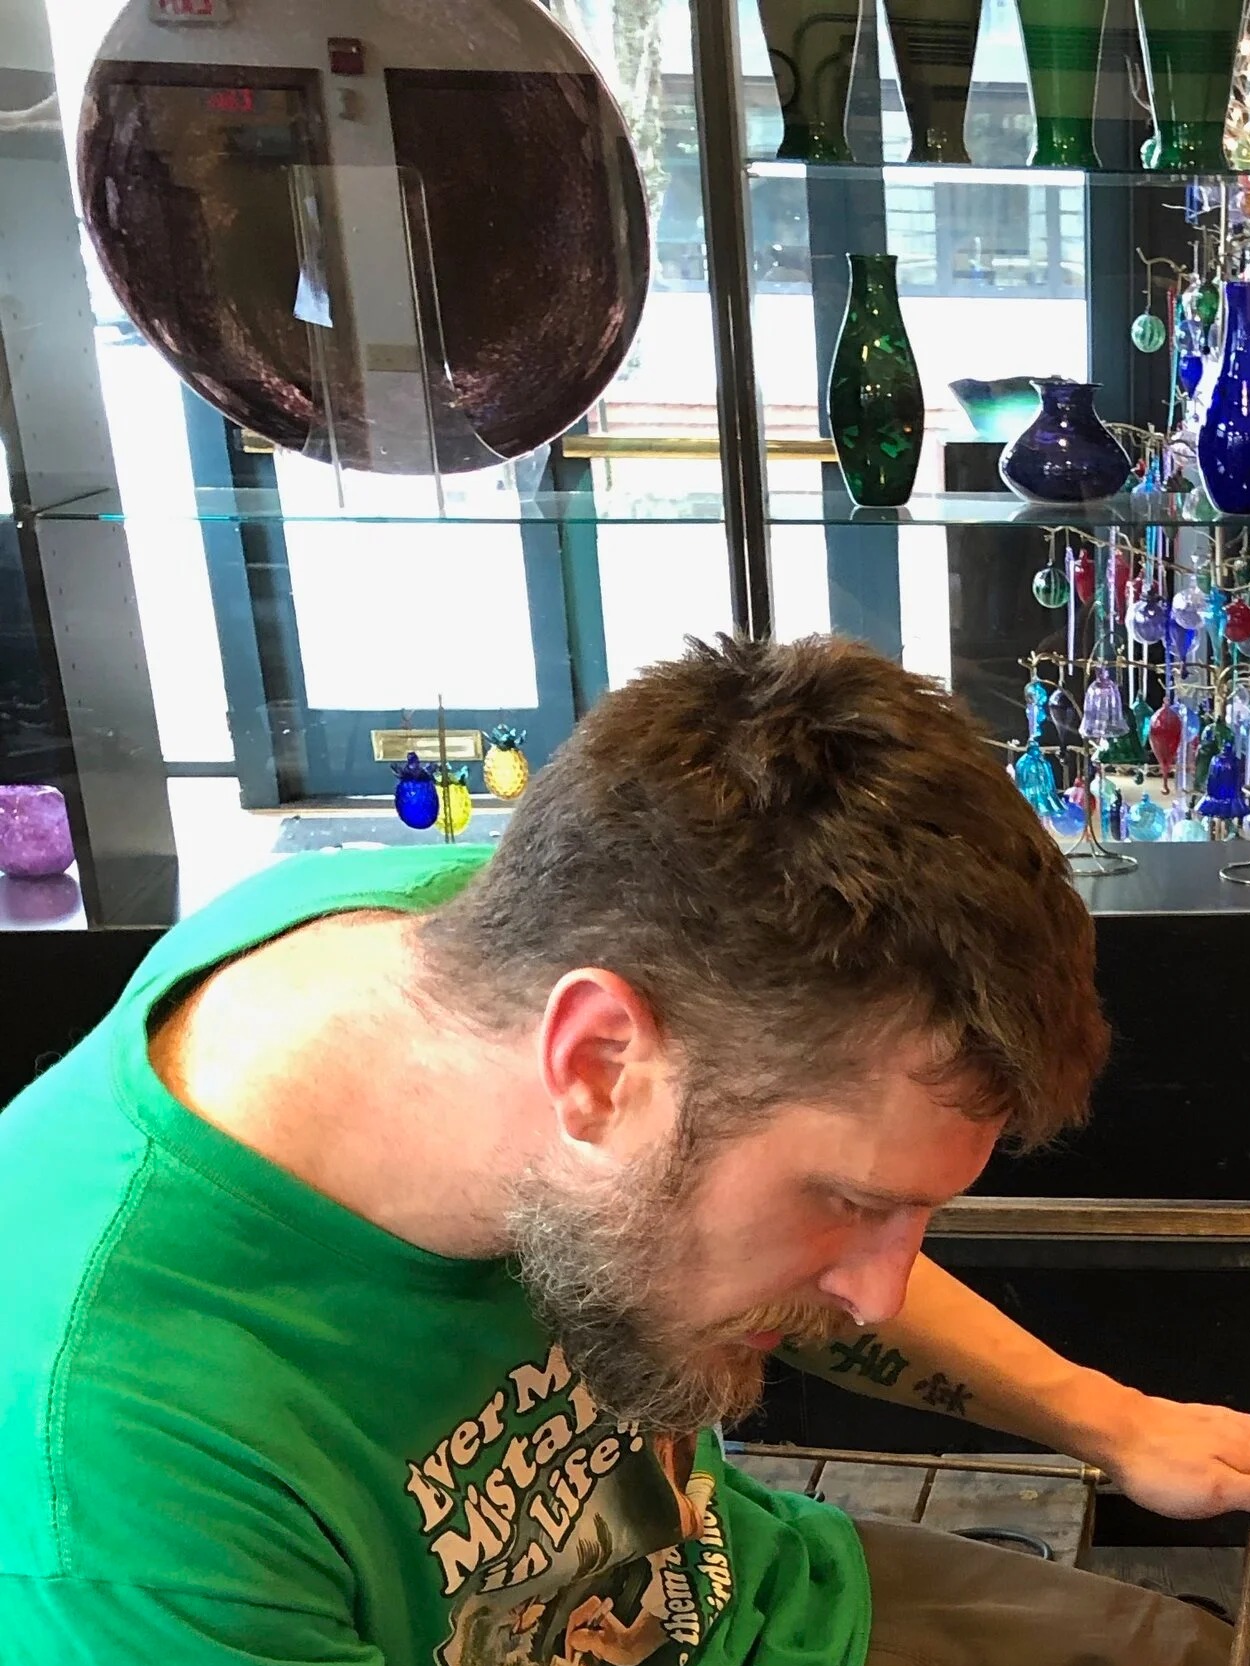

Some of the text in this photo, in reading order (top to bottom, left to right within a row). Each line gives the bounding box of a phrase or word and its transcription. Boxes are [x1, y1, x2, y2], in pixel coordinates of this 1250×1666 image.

[407, 1391, 504, 1533] Ever
[480, 1542, 549, 1592] in
[698, 1551, 733, 1627] irds
[664, 1570, 700, 1647] them
